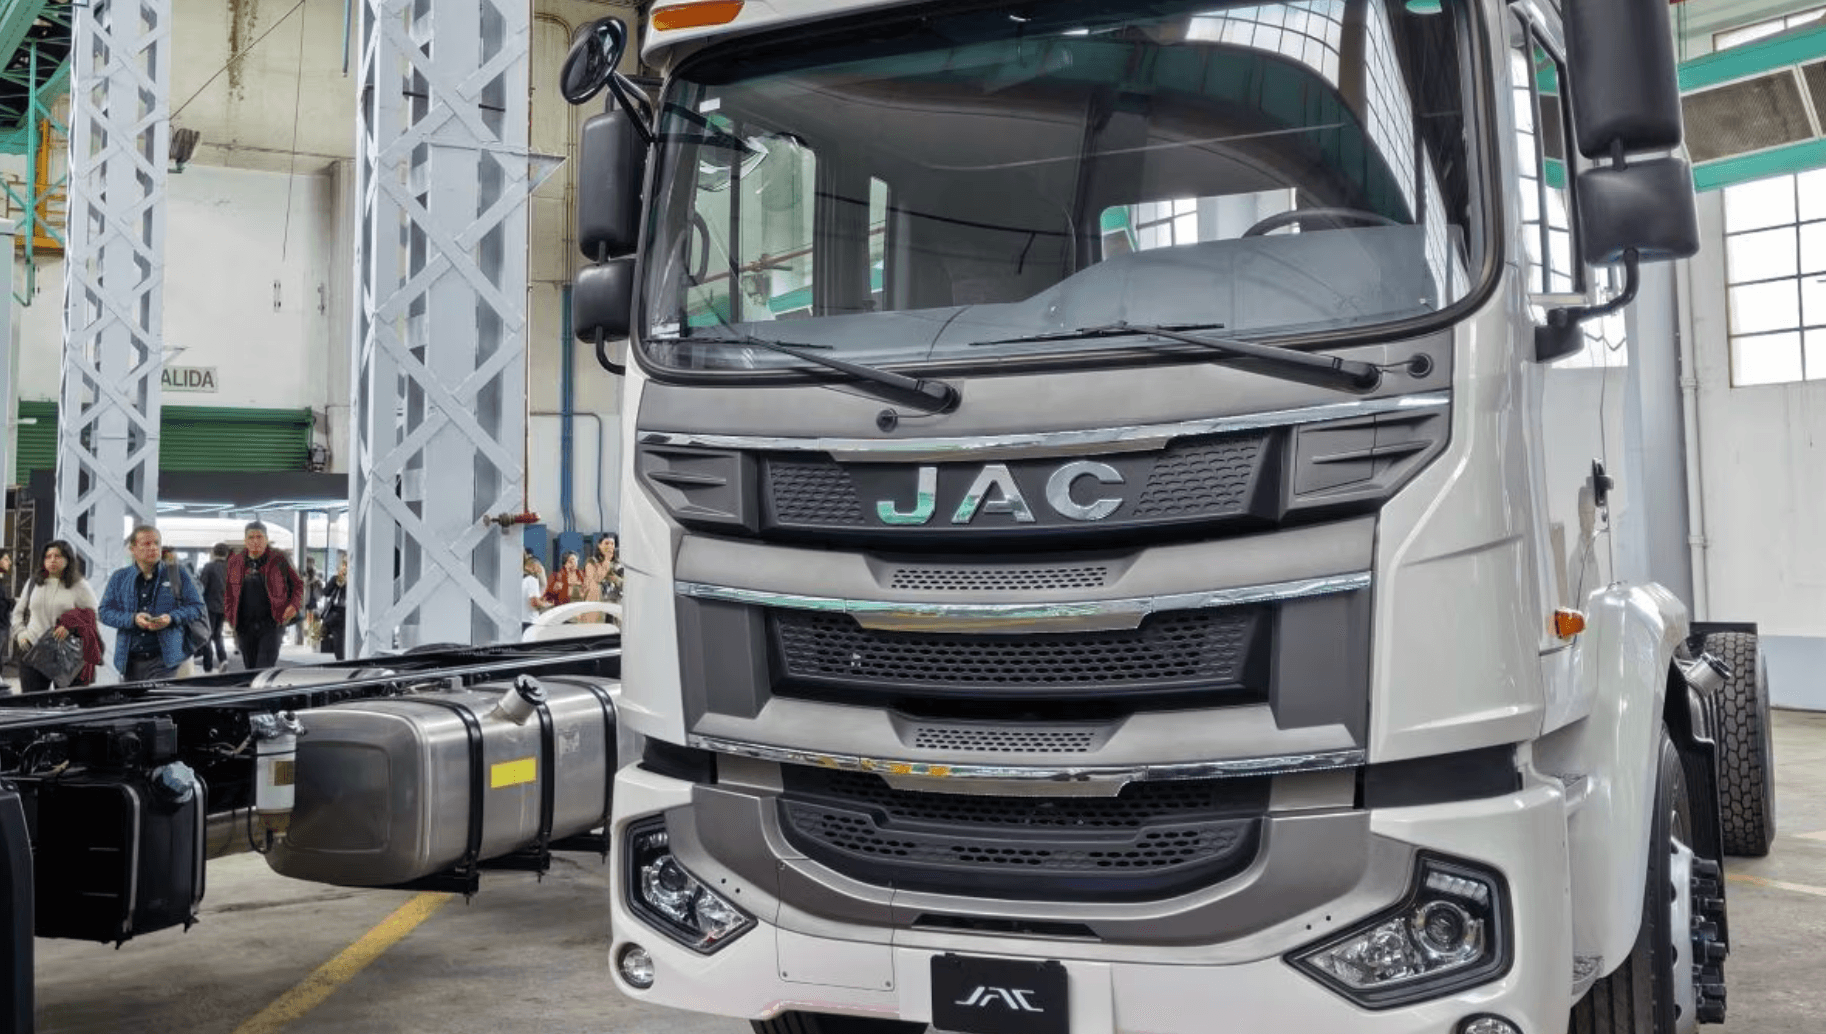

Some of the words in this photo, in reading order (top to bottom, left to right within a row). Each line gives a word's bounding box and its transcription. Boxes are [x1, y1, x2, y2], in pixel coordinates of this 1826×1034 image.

[161, 368, 214, 388] ALIDA
[876, 460, 1125, 524] JAC
[954, 986, 1044, 1012] JAC
